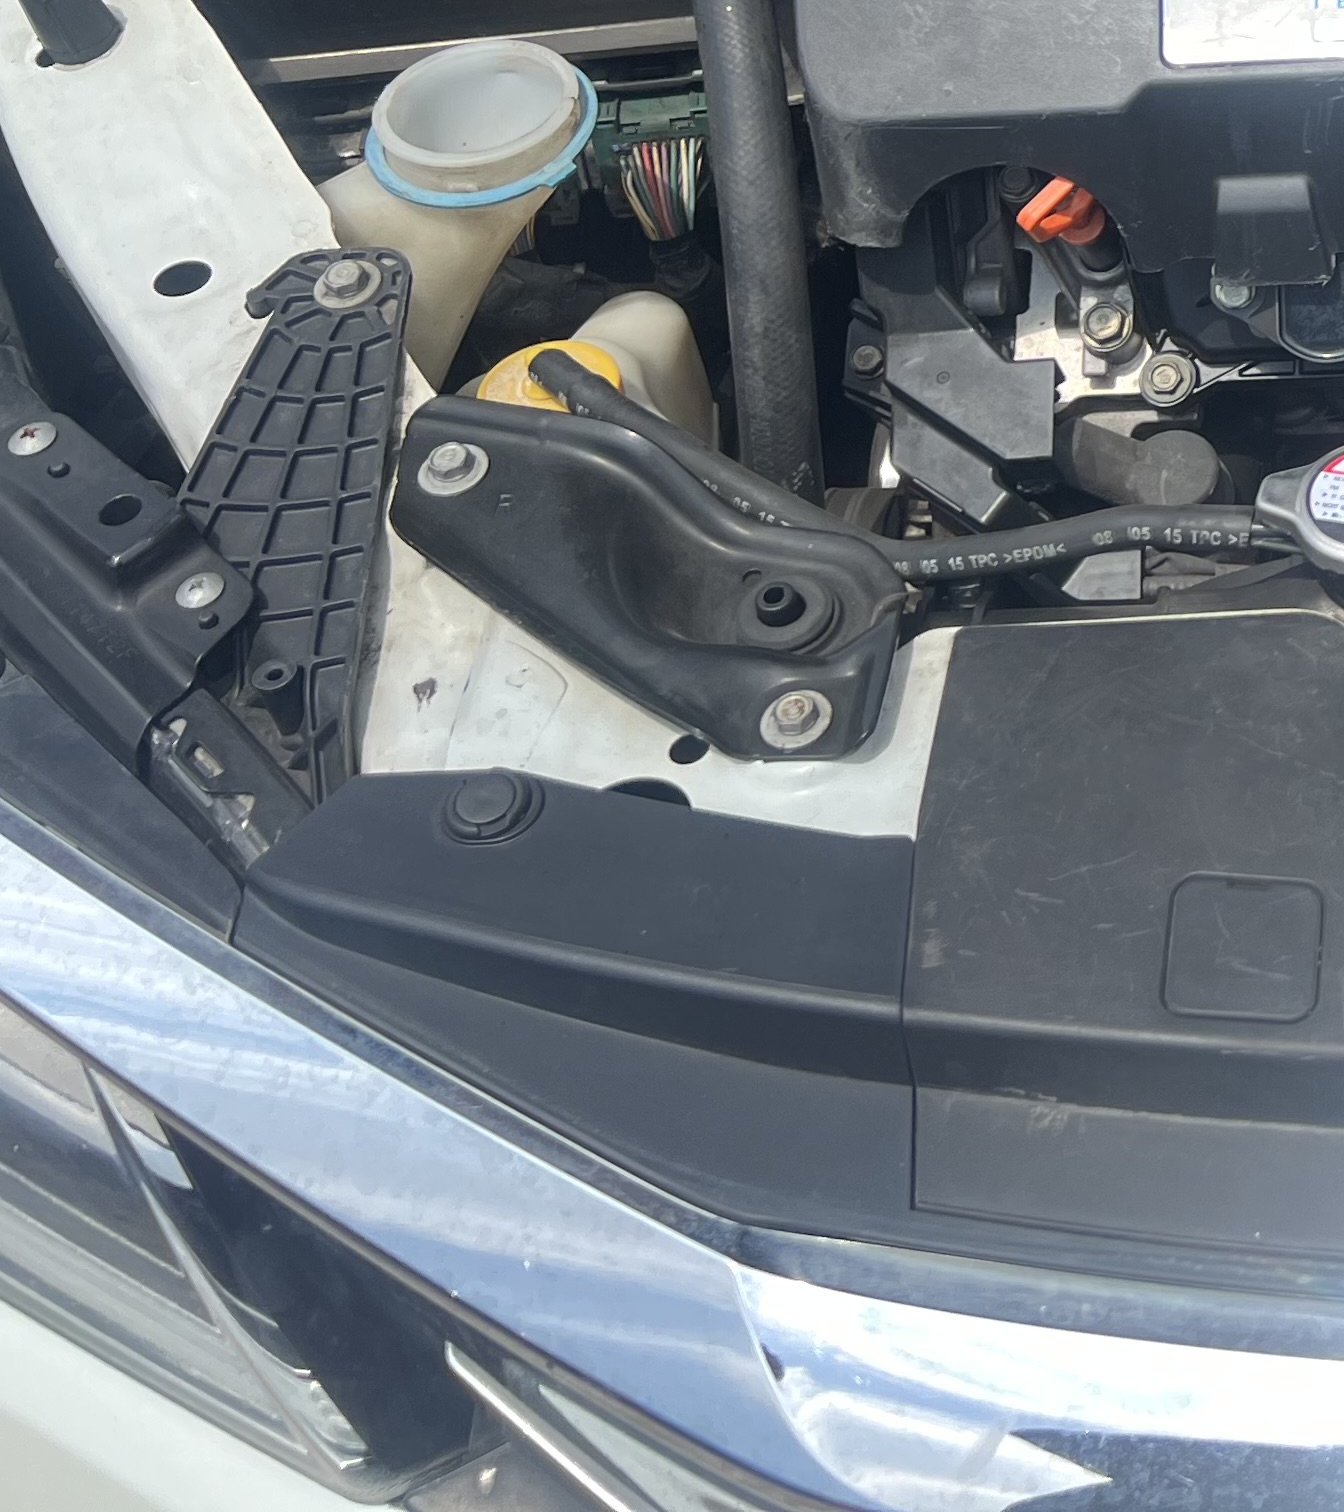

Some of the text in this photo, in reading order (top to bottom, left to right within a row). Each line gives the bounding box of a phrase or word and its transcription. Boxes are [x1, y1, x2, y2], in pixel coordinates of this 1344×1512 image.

[1163, 527, 1183, 544] 15
[948, 556, 965, 571] 15
[968, 552, 998, 569] TPC
